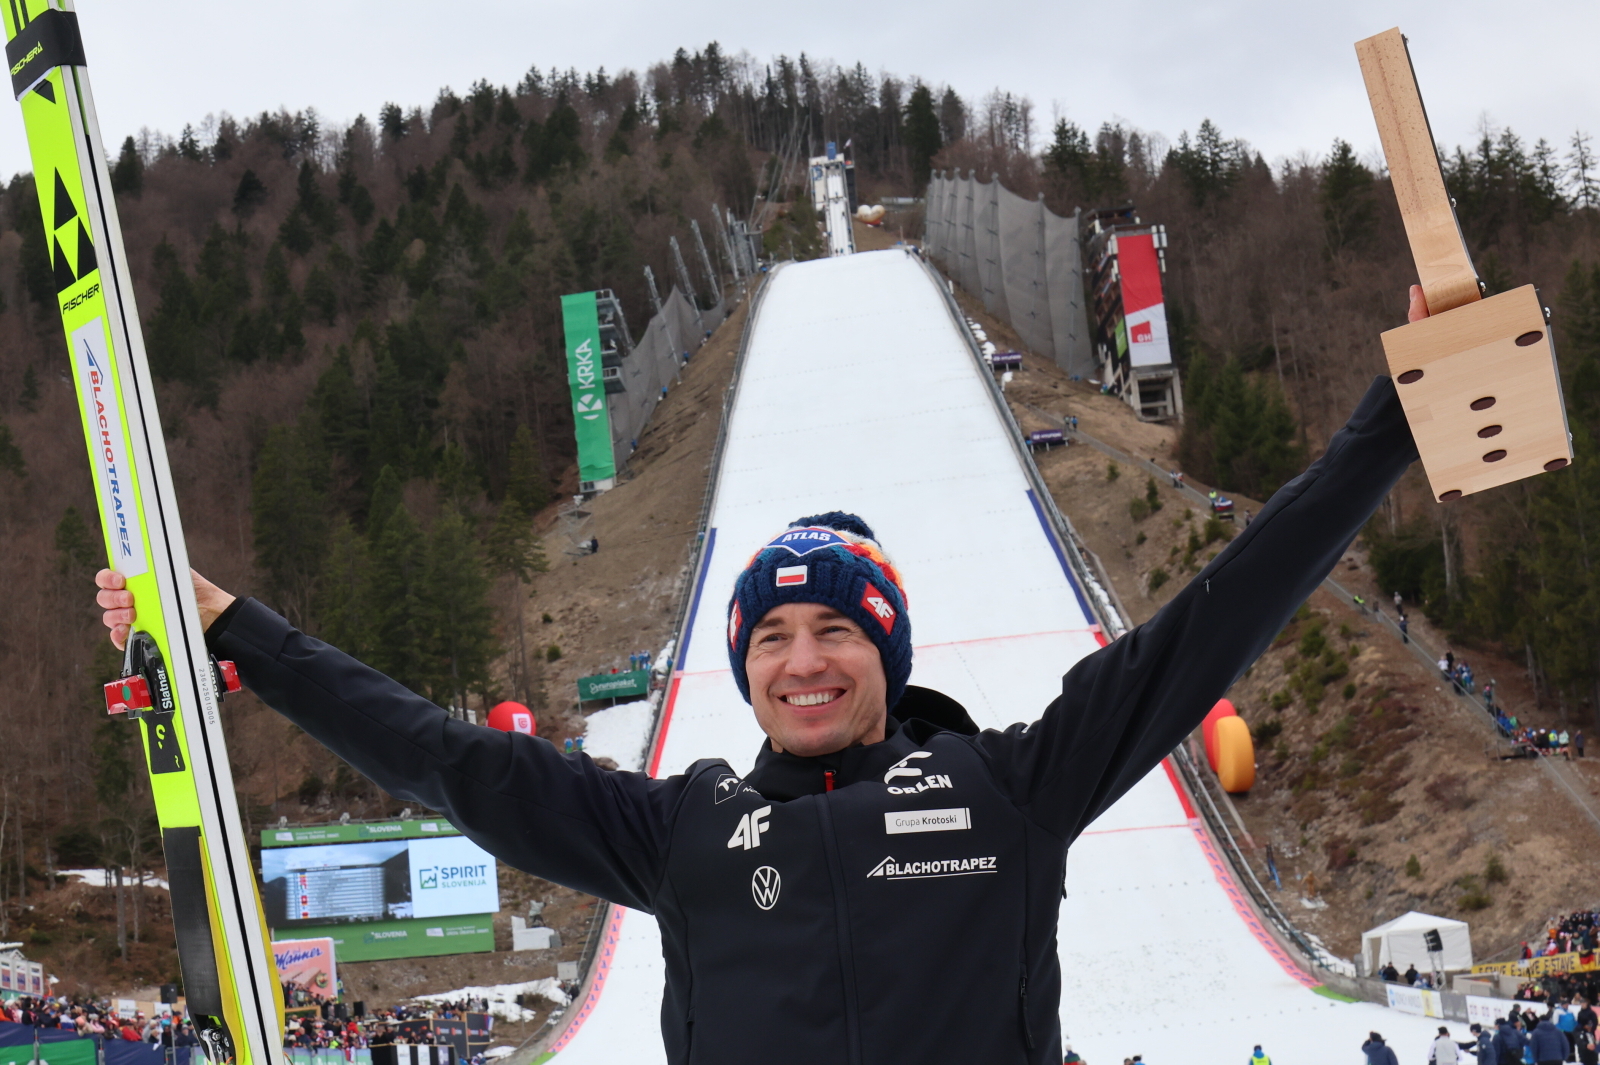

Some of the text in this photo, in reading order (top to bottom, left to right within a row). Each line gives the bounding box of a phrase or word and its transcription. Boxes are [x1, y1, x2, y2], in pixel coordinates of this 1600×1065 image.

[62, 283, 100, 315] FISCHER
[575, 338, 595, 390] KRKA
[89, 370, 132, 557] BLACHOTRAPEZ
[781, 531, 831, 543] ATLAS
[866, 596, 894, 619] 4F
[887, 774, 953, 795] ORLEN
[369, 825, 403, 833] SLOVENIA
[727, 804, 772, 851] 4F
[895, 814, 957, 828] Grupa Krotoski
[441, 864, 487, 880] SPIRIT
[885, 856, 997, 876] BLACHOTRAPEZ
[441, 879, 487, 889] SLOVENIJA
[374, 930, 408, 939] SLOVENIA
[274, 947, 323, 971] Manner
